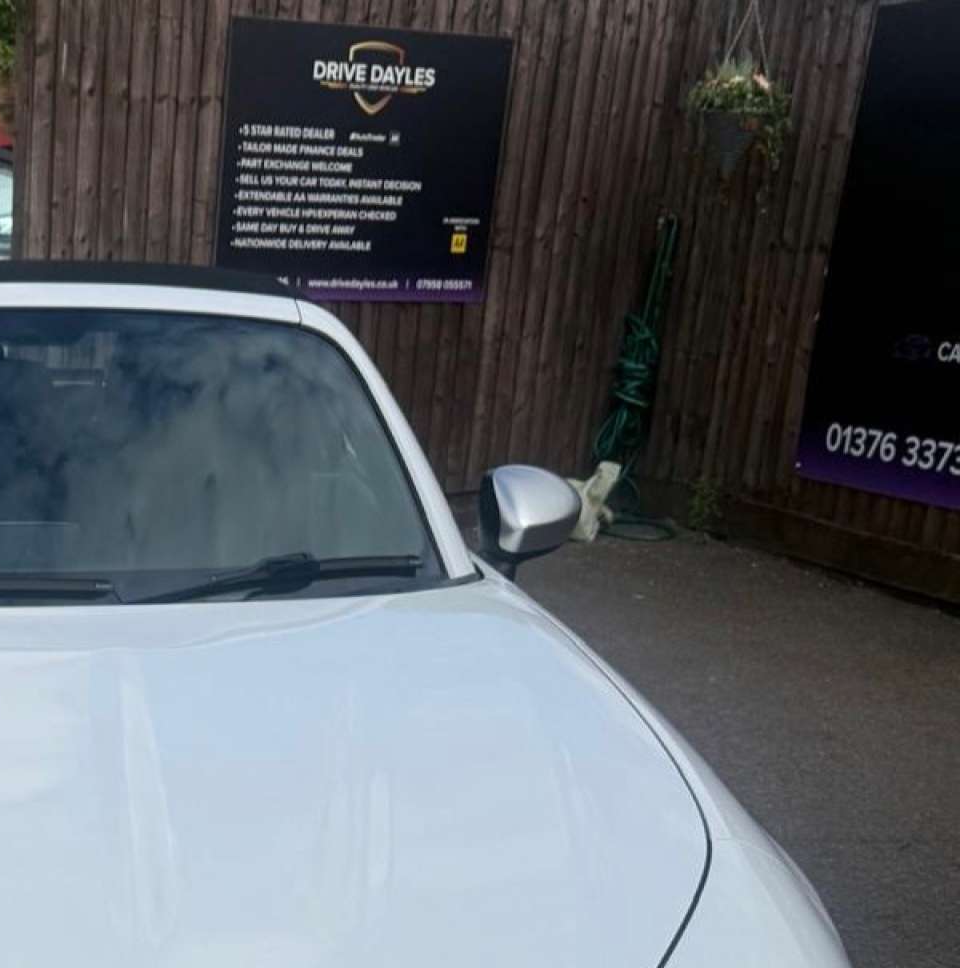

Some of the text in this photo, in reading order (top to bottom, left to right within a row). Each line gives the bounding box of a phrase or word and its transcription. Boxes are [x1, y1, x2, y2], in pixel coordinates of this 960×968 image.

[313, 60, 436, 87] DRIVE DAYLES
[243, 124, 335, 140] 5 STAR RATED DEALER
[242, 142, 364, 158] TAILOR MADE FINANCE DEALS
[241, 158, 353, 173] PART EXCHANGE WELCOME
[239, 174, 259, 185] SELL
[261, 175, 273, 186] US
[275, 176, 298, 187] YOUR
[300, 177, 317, 187] CAR
[348, 179, 383, 190] INSTANT
[383, 180, 422, 192] DECISION
[239, 190, 403, 206] EXTENDABLE AA WARRANTIES AVAILABLE
[237, 206, 265, 217] EVERY
[266, 207, 300, 218] VEHICLE
[359, 210, 397, 221] CHECKED
[236, 221, 259, 232] SAME
[260, 222, 278, 233] DAY
[279, 223, 297, 234] BUY
[305, 224, 330, 235] DRIVE
[331, 225, 356, 235] AWAY
[234, 237, 372, 251] NATIONWIDE DELIVERY AVAILABLE
[825, 422, 898, 463] 01376
